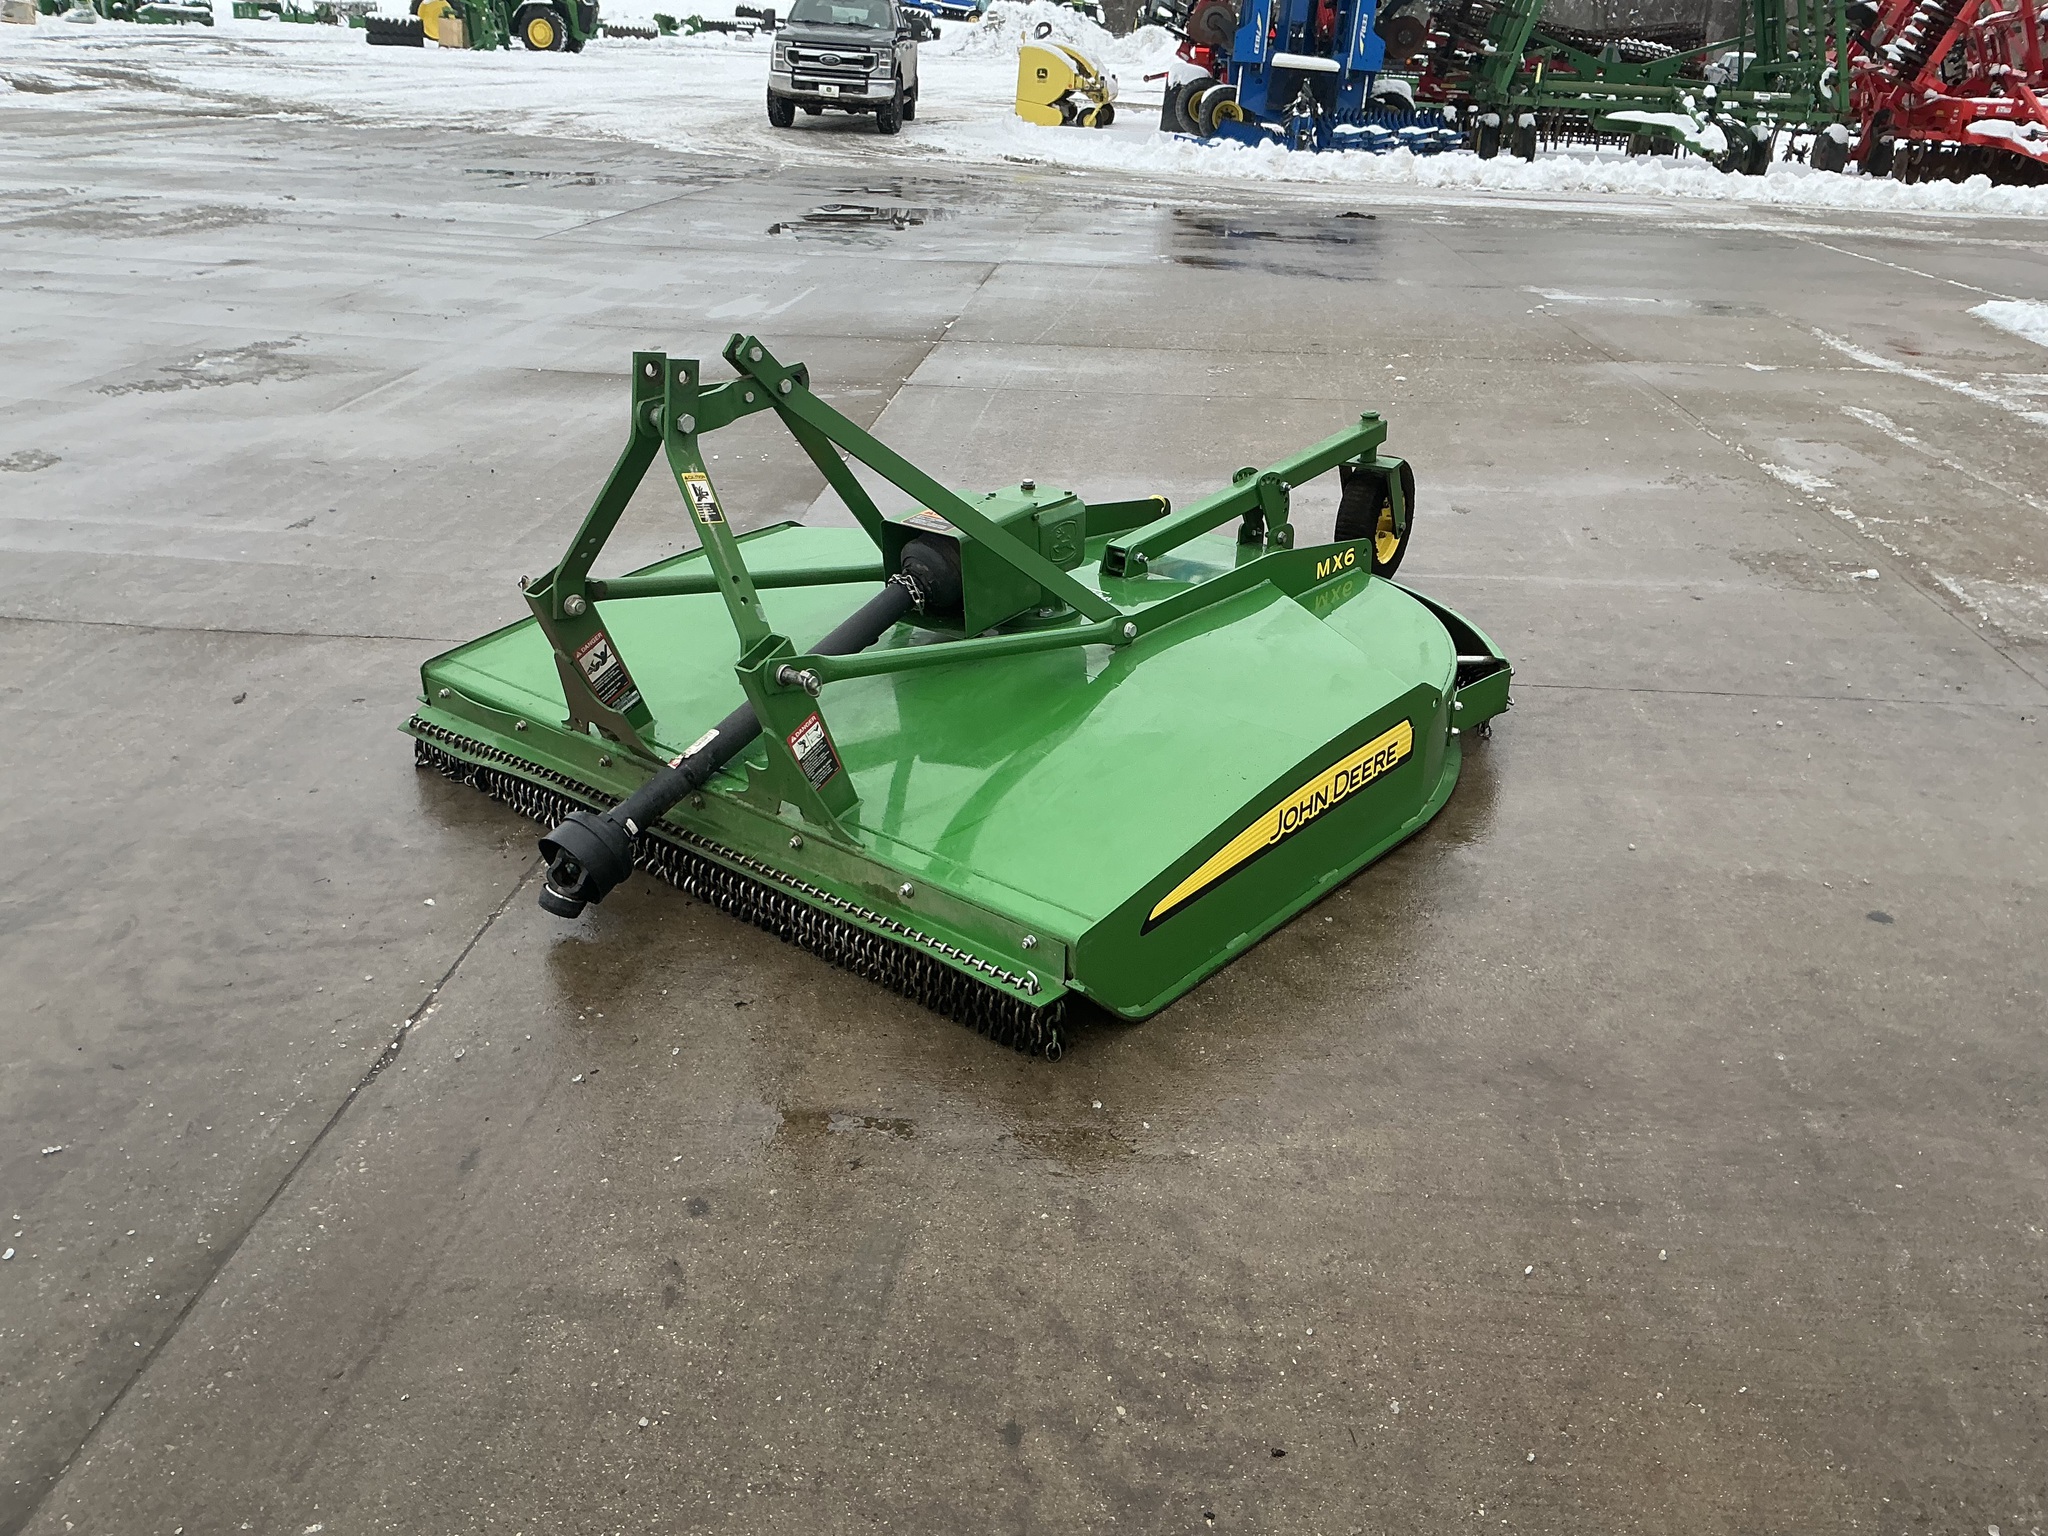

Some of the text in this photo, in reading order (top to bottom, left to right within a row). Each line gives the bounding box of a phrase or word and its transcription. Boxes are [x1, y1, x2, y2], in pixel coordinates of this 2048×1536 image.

[1316, 547, 1355, 580] MX6
[580, 632, 603, 653] DANGER
[794, 715, 817, 738] DANGER
[1269, 740, 1399, 842] JOHN DEERE
